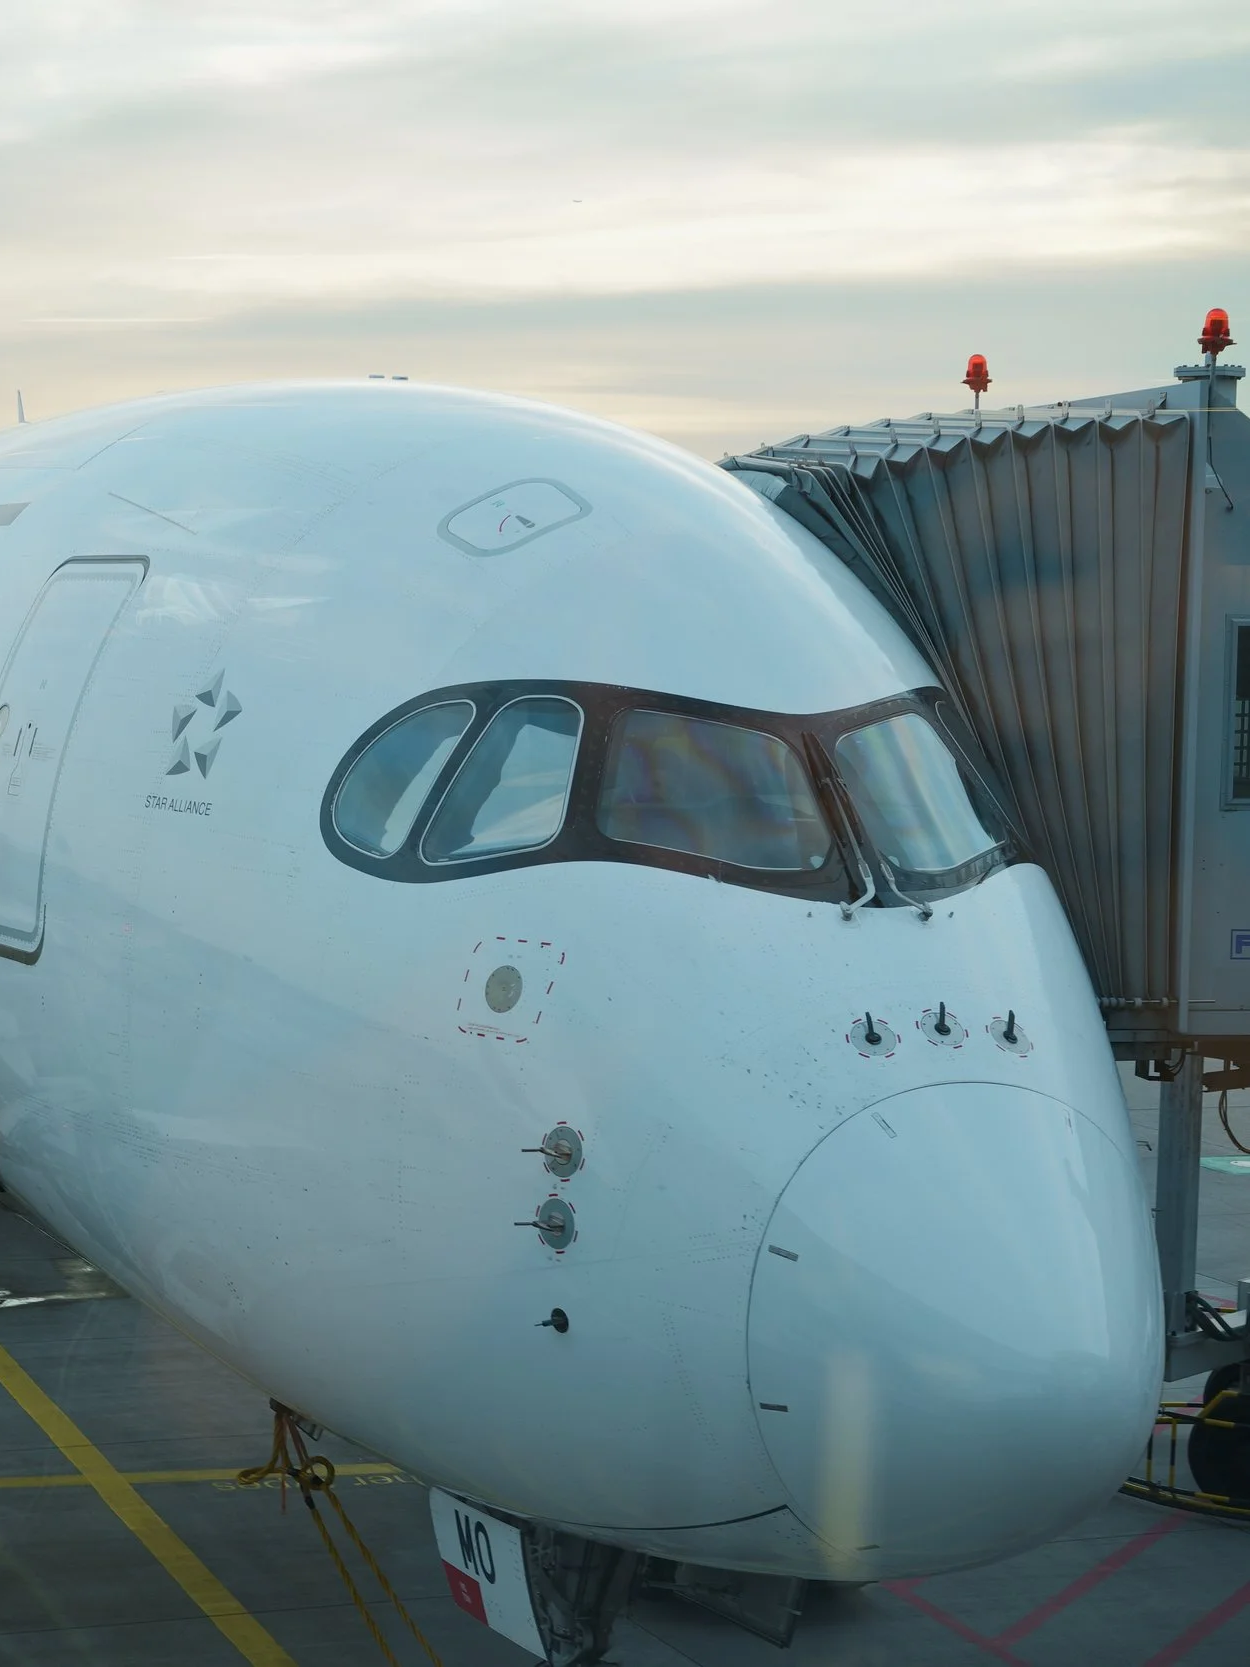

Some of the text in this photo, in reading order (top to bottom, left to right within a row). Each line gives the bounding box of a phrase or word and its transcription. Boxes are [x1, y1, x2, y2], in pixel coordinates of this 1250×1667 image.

[144, 794, 213, 817] STAR ALLIANCE
[453, 1508, 496, 1585] MO
